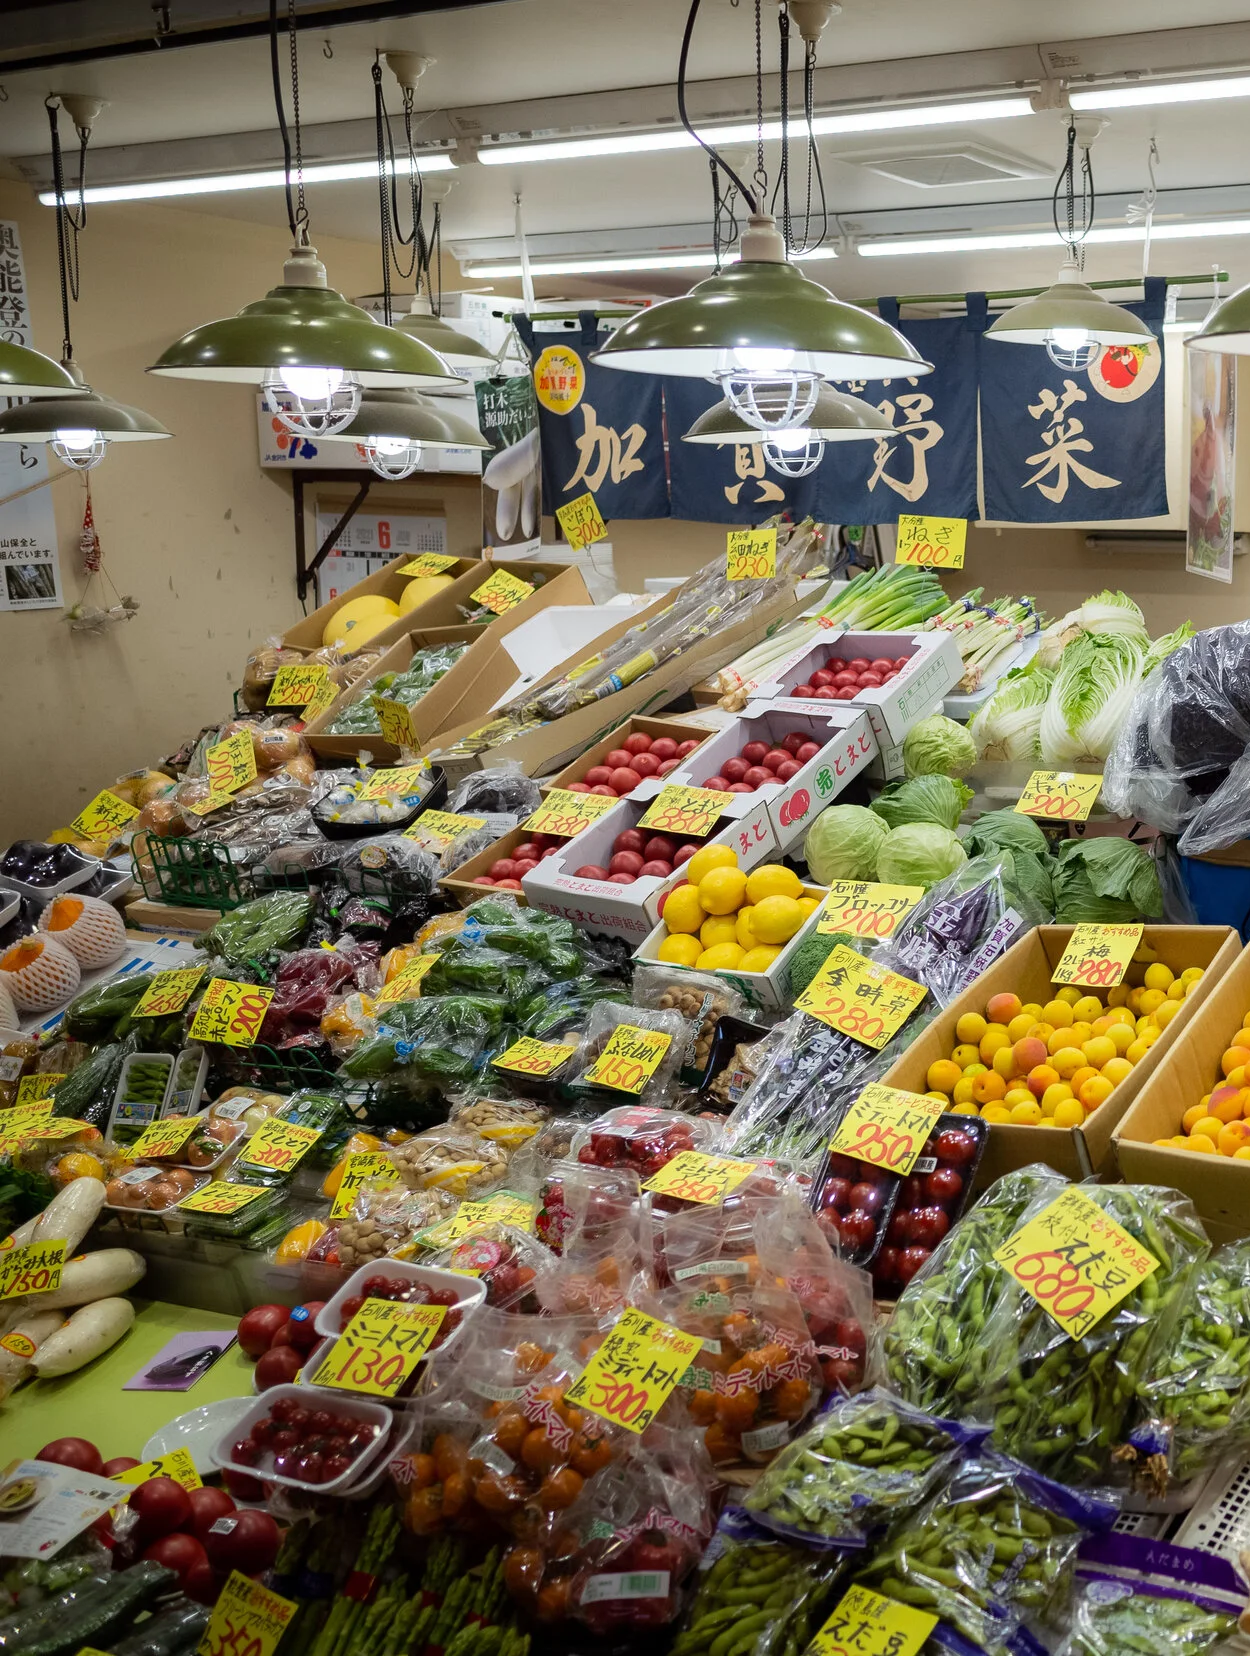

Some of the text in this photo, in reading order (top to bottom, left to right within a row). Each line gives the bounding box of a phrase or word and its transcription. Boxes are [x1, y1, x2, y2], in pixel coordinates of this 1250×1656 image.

[483, 392, 508, 411] 打木
[377, 520, 392, 550] 6
[906, 523, 959, 546] ねぎ
[834, 731, 872, 777] とまと
[1028, 780, 1097, 800] キャベツ
[679, 798, 724, 816] とまと
[535, 812, 590, 836] 1380
[831, 881, 871, 895] 石川産
[832, 895, 916, 915] ブロッコリー
[827, 907, 896, 937] 200
[830, 950, 868, 974] 石川産
[1083, 943, 1111, 958] 梅
[826, 966, 915, 1016] 金時草
[605, 1039, 666, 1063] ぶなしめじ
[864, 1086, 942, 1116] 石川産 サービス品
[854, 1100, 931, 1134] ミディートマト
[259, 1131, 311, 1154] ししとう
[1090, 1217, 1151, 1275] おすすめ品
[1053, 1231, 1131, 1300] えだ豆
[359, 1303, 398, 1321] 石川産
[618, 1312, 655, 1337] 石川産
[345, 1320, 430, 1354] ミニトマト
[597, 1352, 679, 1392] ミディートマト
[823, 1611, 909, 1656] えだ豆
